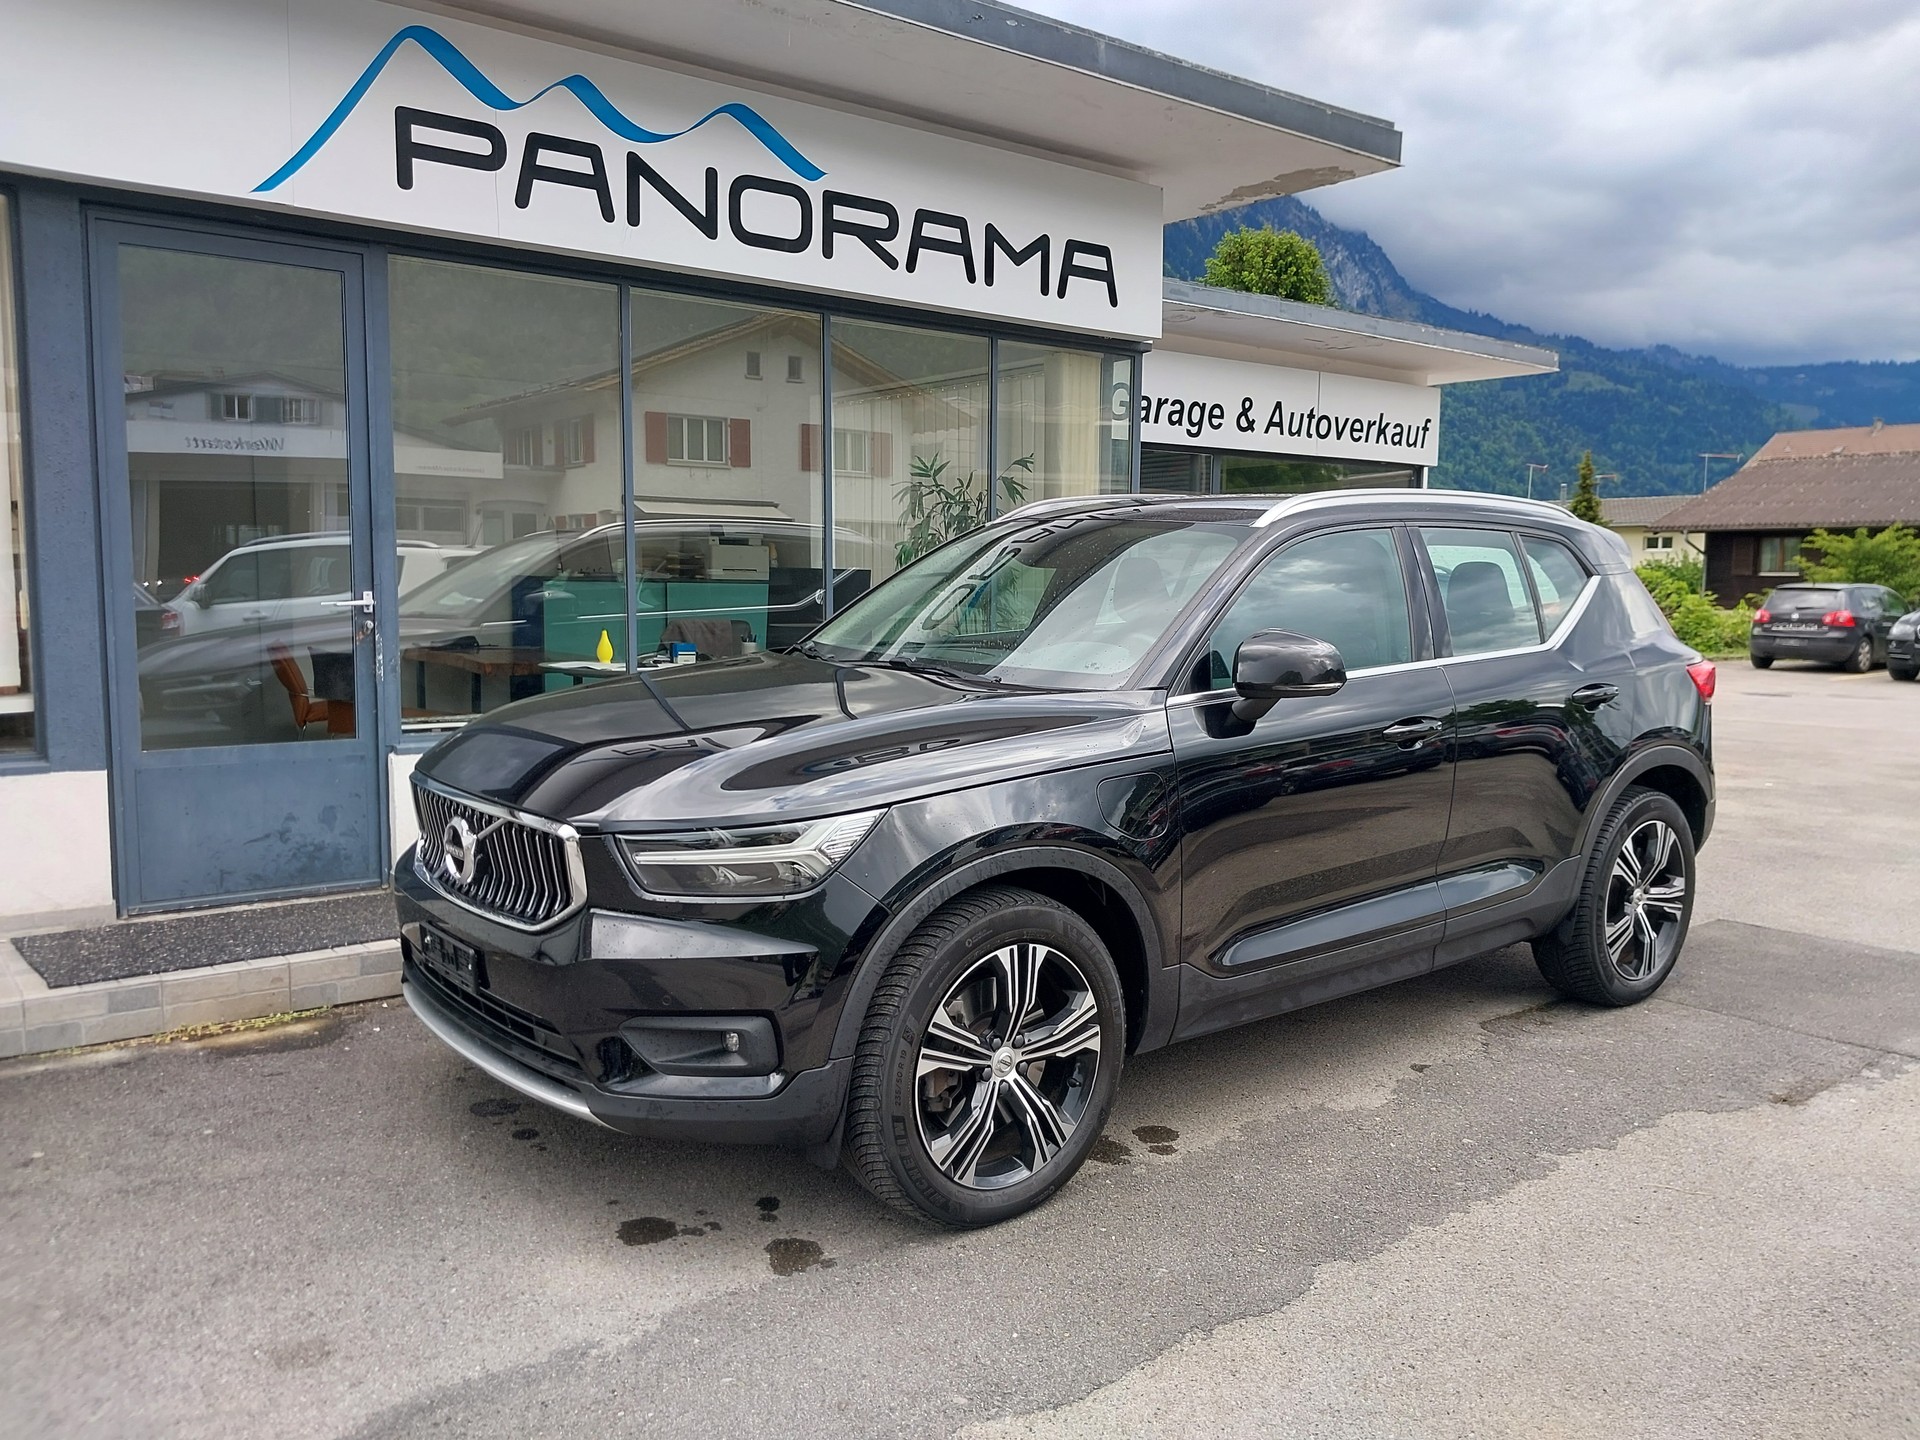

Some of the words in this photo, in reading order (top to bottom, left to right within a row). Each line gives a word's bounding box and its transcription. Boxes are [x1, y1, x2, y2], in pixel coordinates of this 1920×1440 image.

[395, 105, 1119, 308] PANORAMA
[1236, 396, 1257, 433] &
[1264, 401, 1432, 449] Autoverkauf
